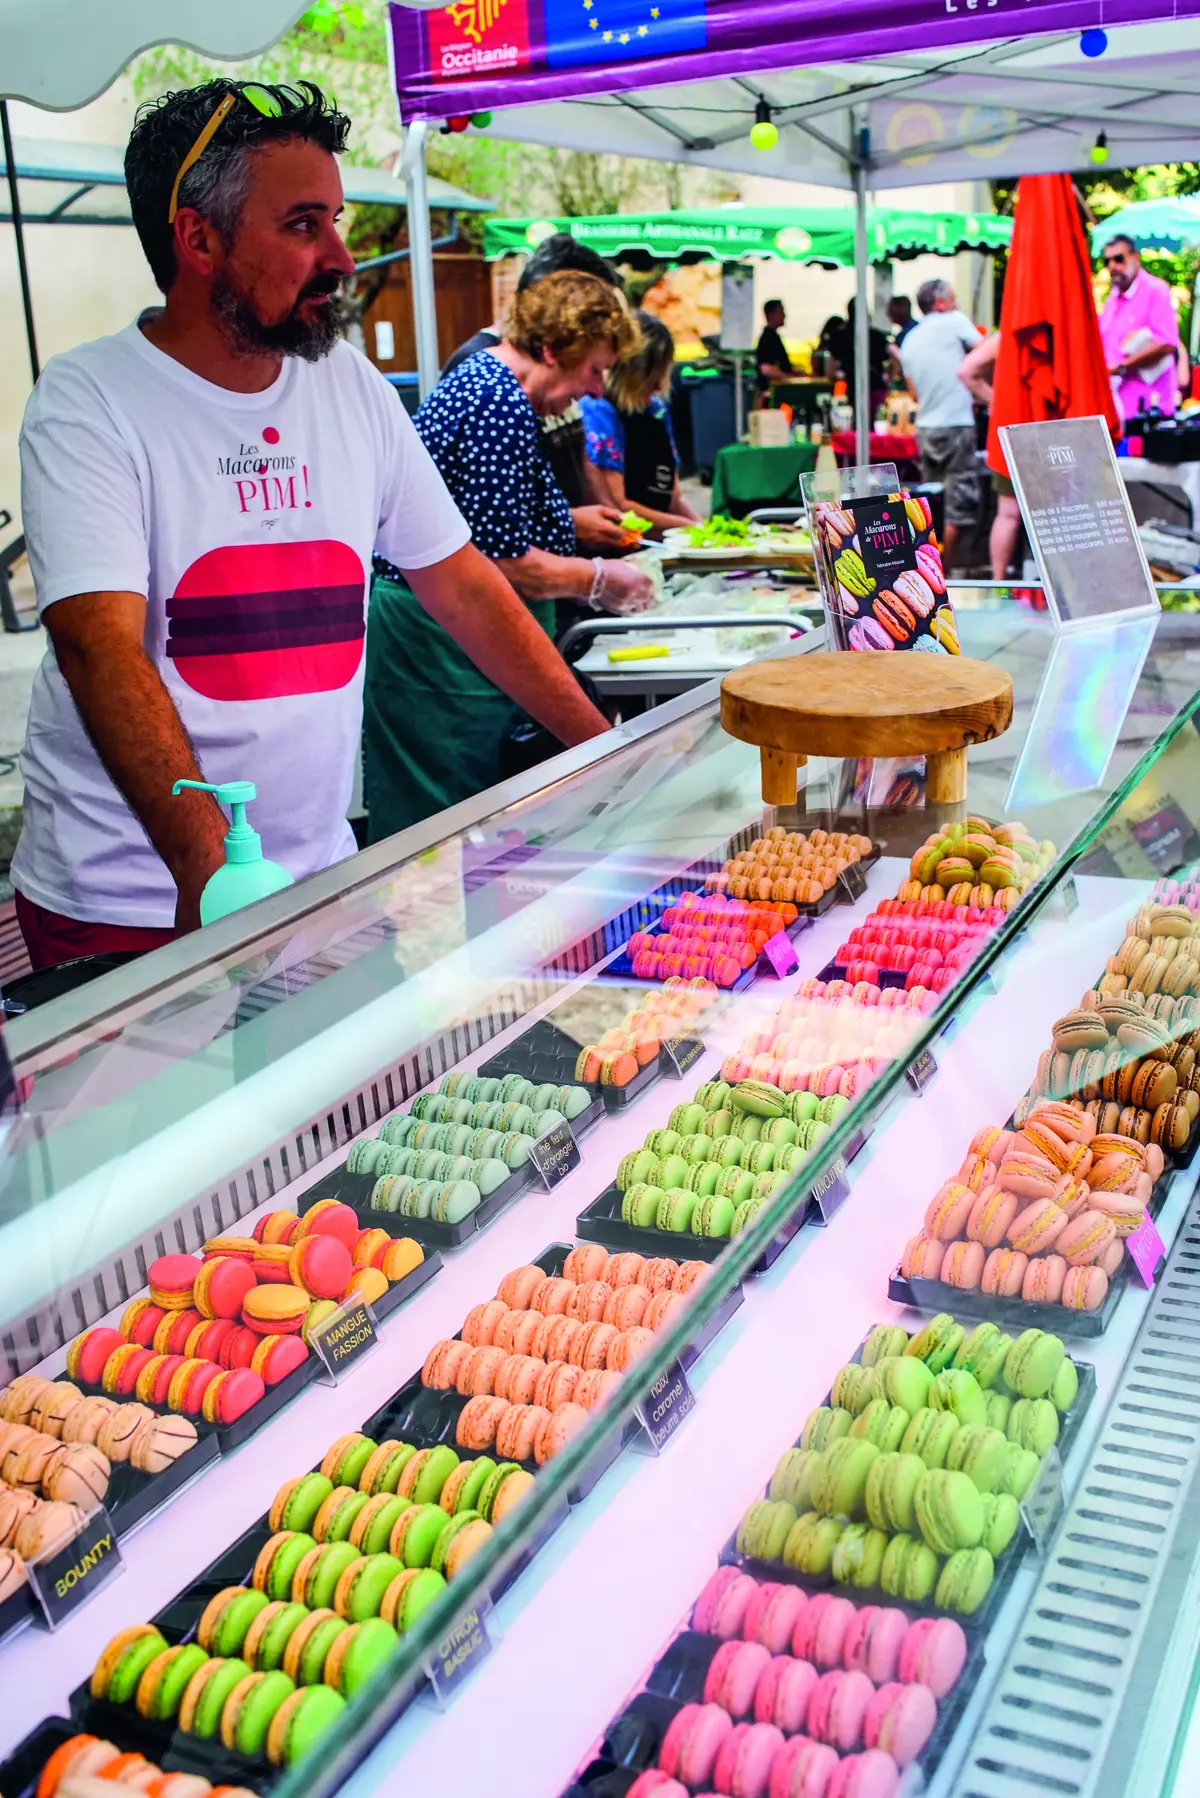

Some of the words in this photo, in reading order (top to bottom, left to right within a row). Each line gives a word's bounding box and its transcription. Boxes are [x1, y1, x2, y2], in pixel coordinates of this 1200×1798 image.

[441, 43, 518, 69] Occitanie
[216, 456, 296, 476] Macarons
[239, 443, 260, 456] Les
[864, 523, 897, 535] Macarons
[538, 1140, 551, 1155] thé
[558, 1163, 570, 1176] bio
[817, 1159, 844, 1196] MOJITO
[325, 1309, 367, 1347] MANGUE
[333, 1324, 373, 1361] PASSION
[652, 1379, 684, 1422] caramel
[654, 1413, 679, 1446] beurre
[679, 1391, 695, 1416] salé
[55, 1533, 111, 1598] BOUNTY
[439, 1609, 479, 1659] CITRON
[444, 1628, 488, 1678] BASILIC
